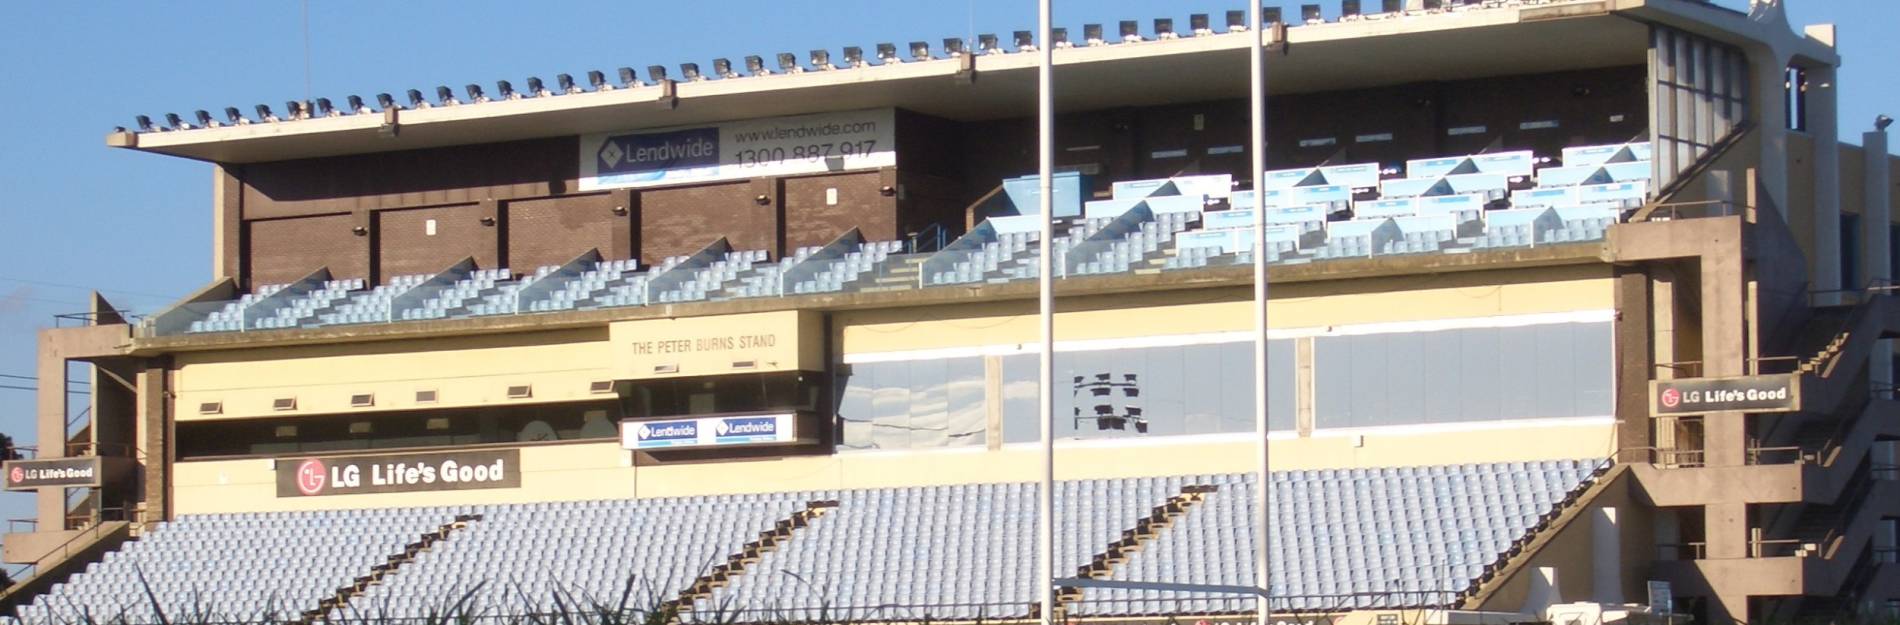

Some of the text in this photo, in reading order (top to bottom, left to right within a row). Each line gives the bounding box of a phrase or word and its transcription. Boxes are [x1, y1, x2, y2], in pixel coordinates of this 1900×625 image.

[735, 121, 877, 143] www.lendwide.com
[626, 138, 713, 163] Lendwide
[735, 140, 877, 168] 1300 887 917
[632, 334, 776, 355] THE PETER BURNS STAND
[1683, 387, 1786, 404] LG Life's Good
[651, 424, 696, 438] Lendwide
[729, 419, 774, 434] Lendwide
[25, 467, 93, 480] LG Life's Good
[331, 459, 504, 488] LG Life's Good
